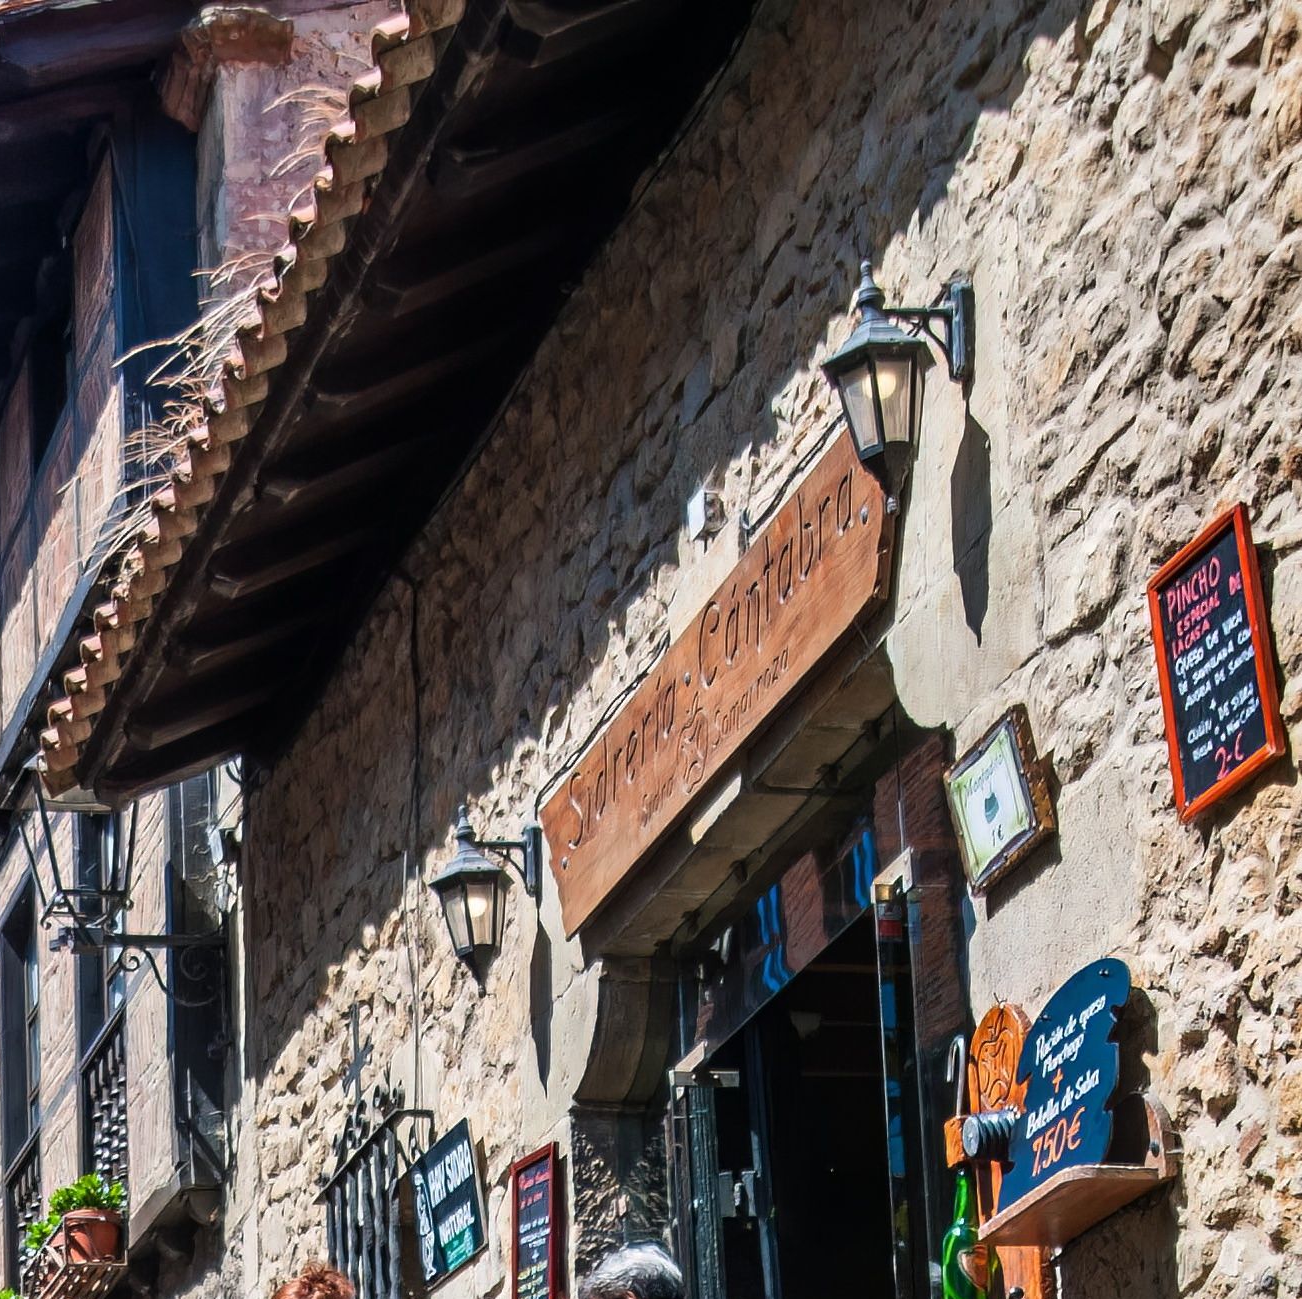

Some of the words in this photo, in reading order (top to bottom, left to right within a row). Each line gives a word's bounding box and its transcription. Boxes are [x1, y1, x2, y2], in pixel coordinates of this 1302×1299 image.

[1167, 556, 1221, 622] PINCHO
[567, 676, 677, 850] Sidrería
[698, 466, 854, 690] Cántabra
[1176, 647, 1204, 679] QUESO
[1060, 1086, 1074, 1111] de
[446, 1139, 474, 1193] SIDRA
[439, 1198, 475, 1247] NATURAL
